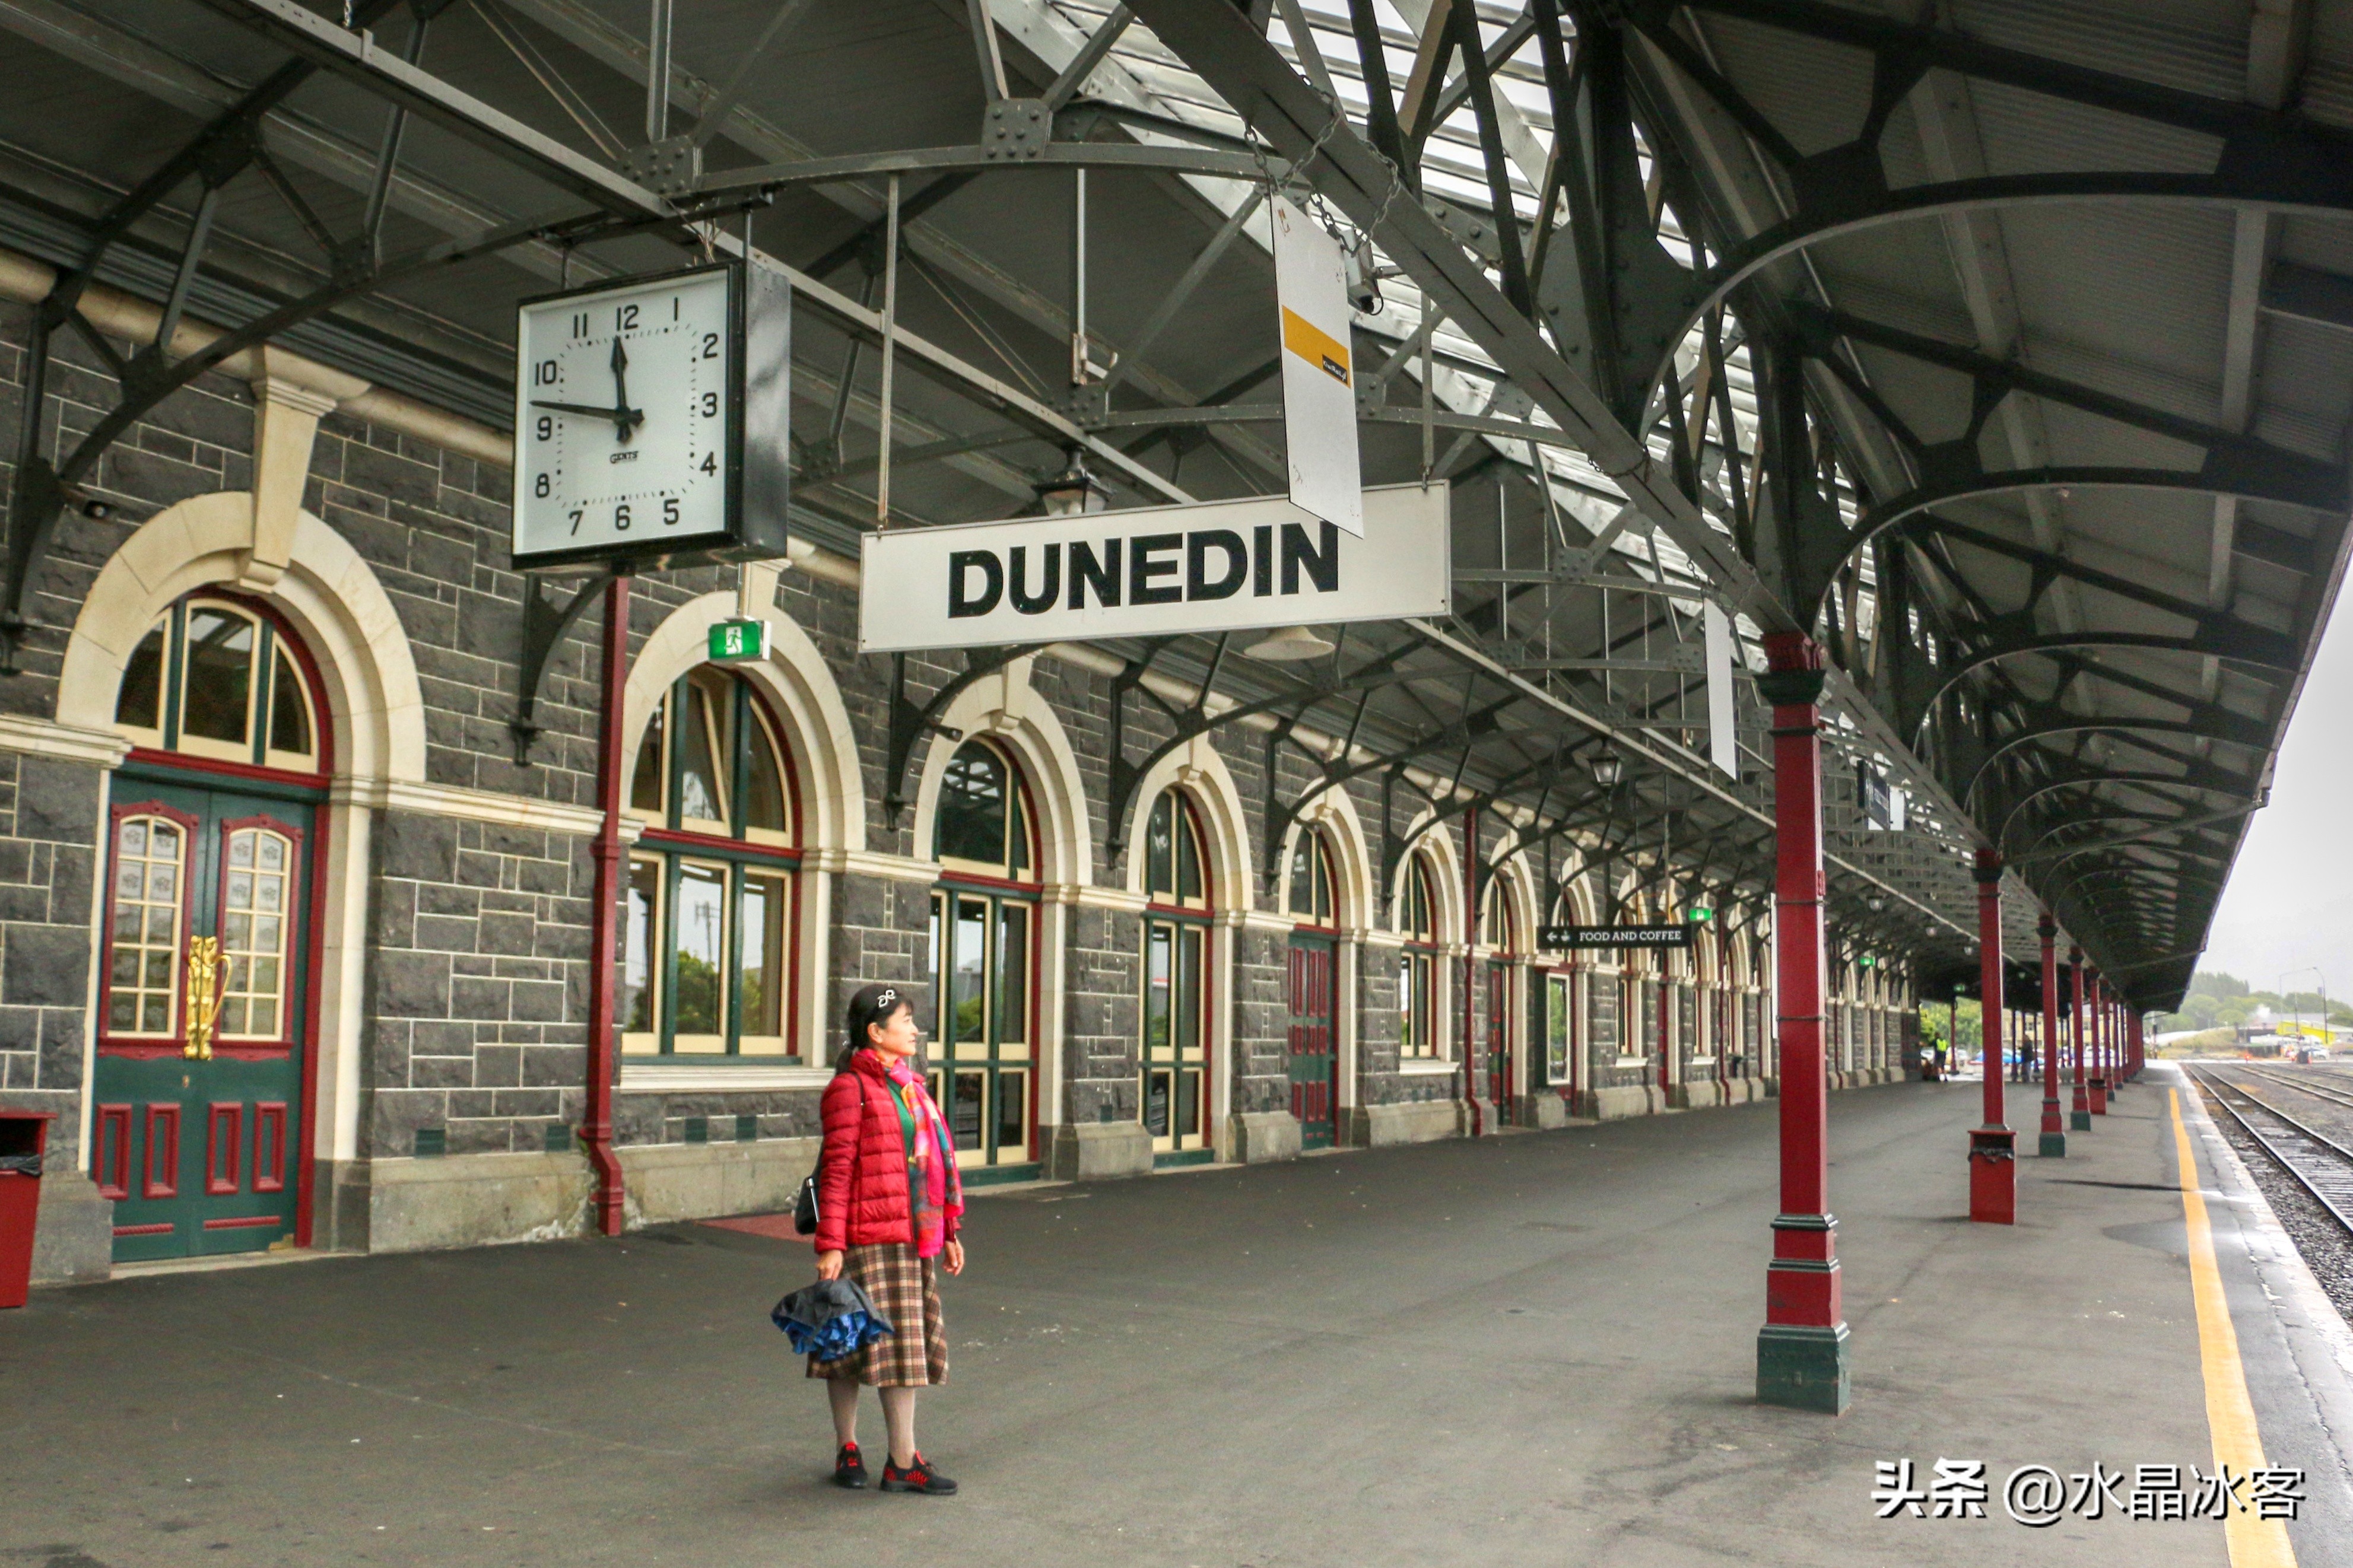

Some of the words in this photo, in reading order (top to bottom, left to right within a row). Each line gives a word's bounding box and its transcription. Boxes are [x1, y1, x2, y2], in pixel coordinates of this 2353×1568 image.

[616, 304, 639, 332] 12
[674, 297, 678, 321] 1
[573, 312, 589, 339] 11
[703, 333, 718, 359] 2
[535, 360, 558, 387] 10
[701, 392, 717, 418] 3
[536, 416, 552, 441] 9
[700, 451, 717, 477] 4
[535, 473, 550, 498] 8
[568, 510, 583, 536] 7
[615, 505, 630, 530] 6
[663, 499, 679, 525] 5
[949, 519, 1339, 618] DUNEDIN
[1579, 931, 1610, 942] FOOD
[1612, 931, 1637, 941] AND
[1638, 930, 1681, 941] COFFEE
